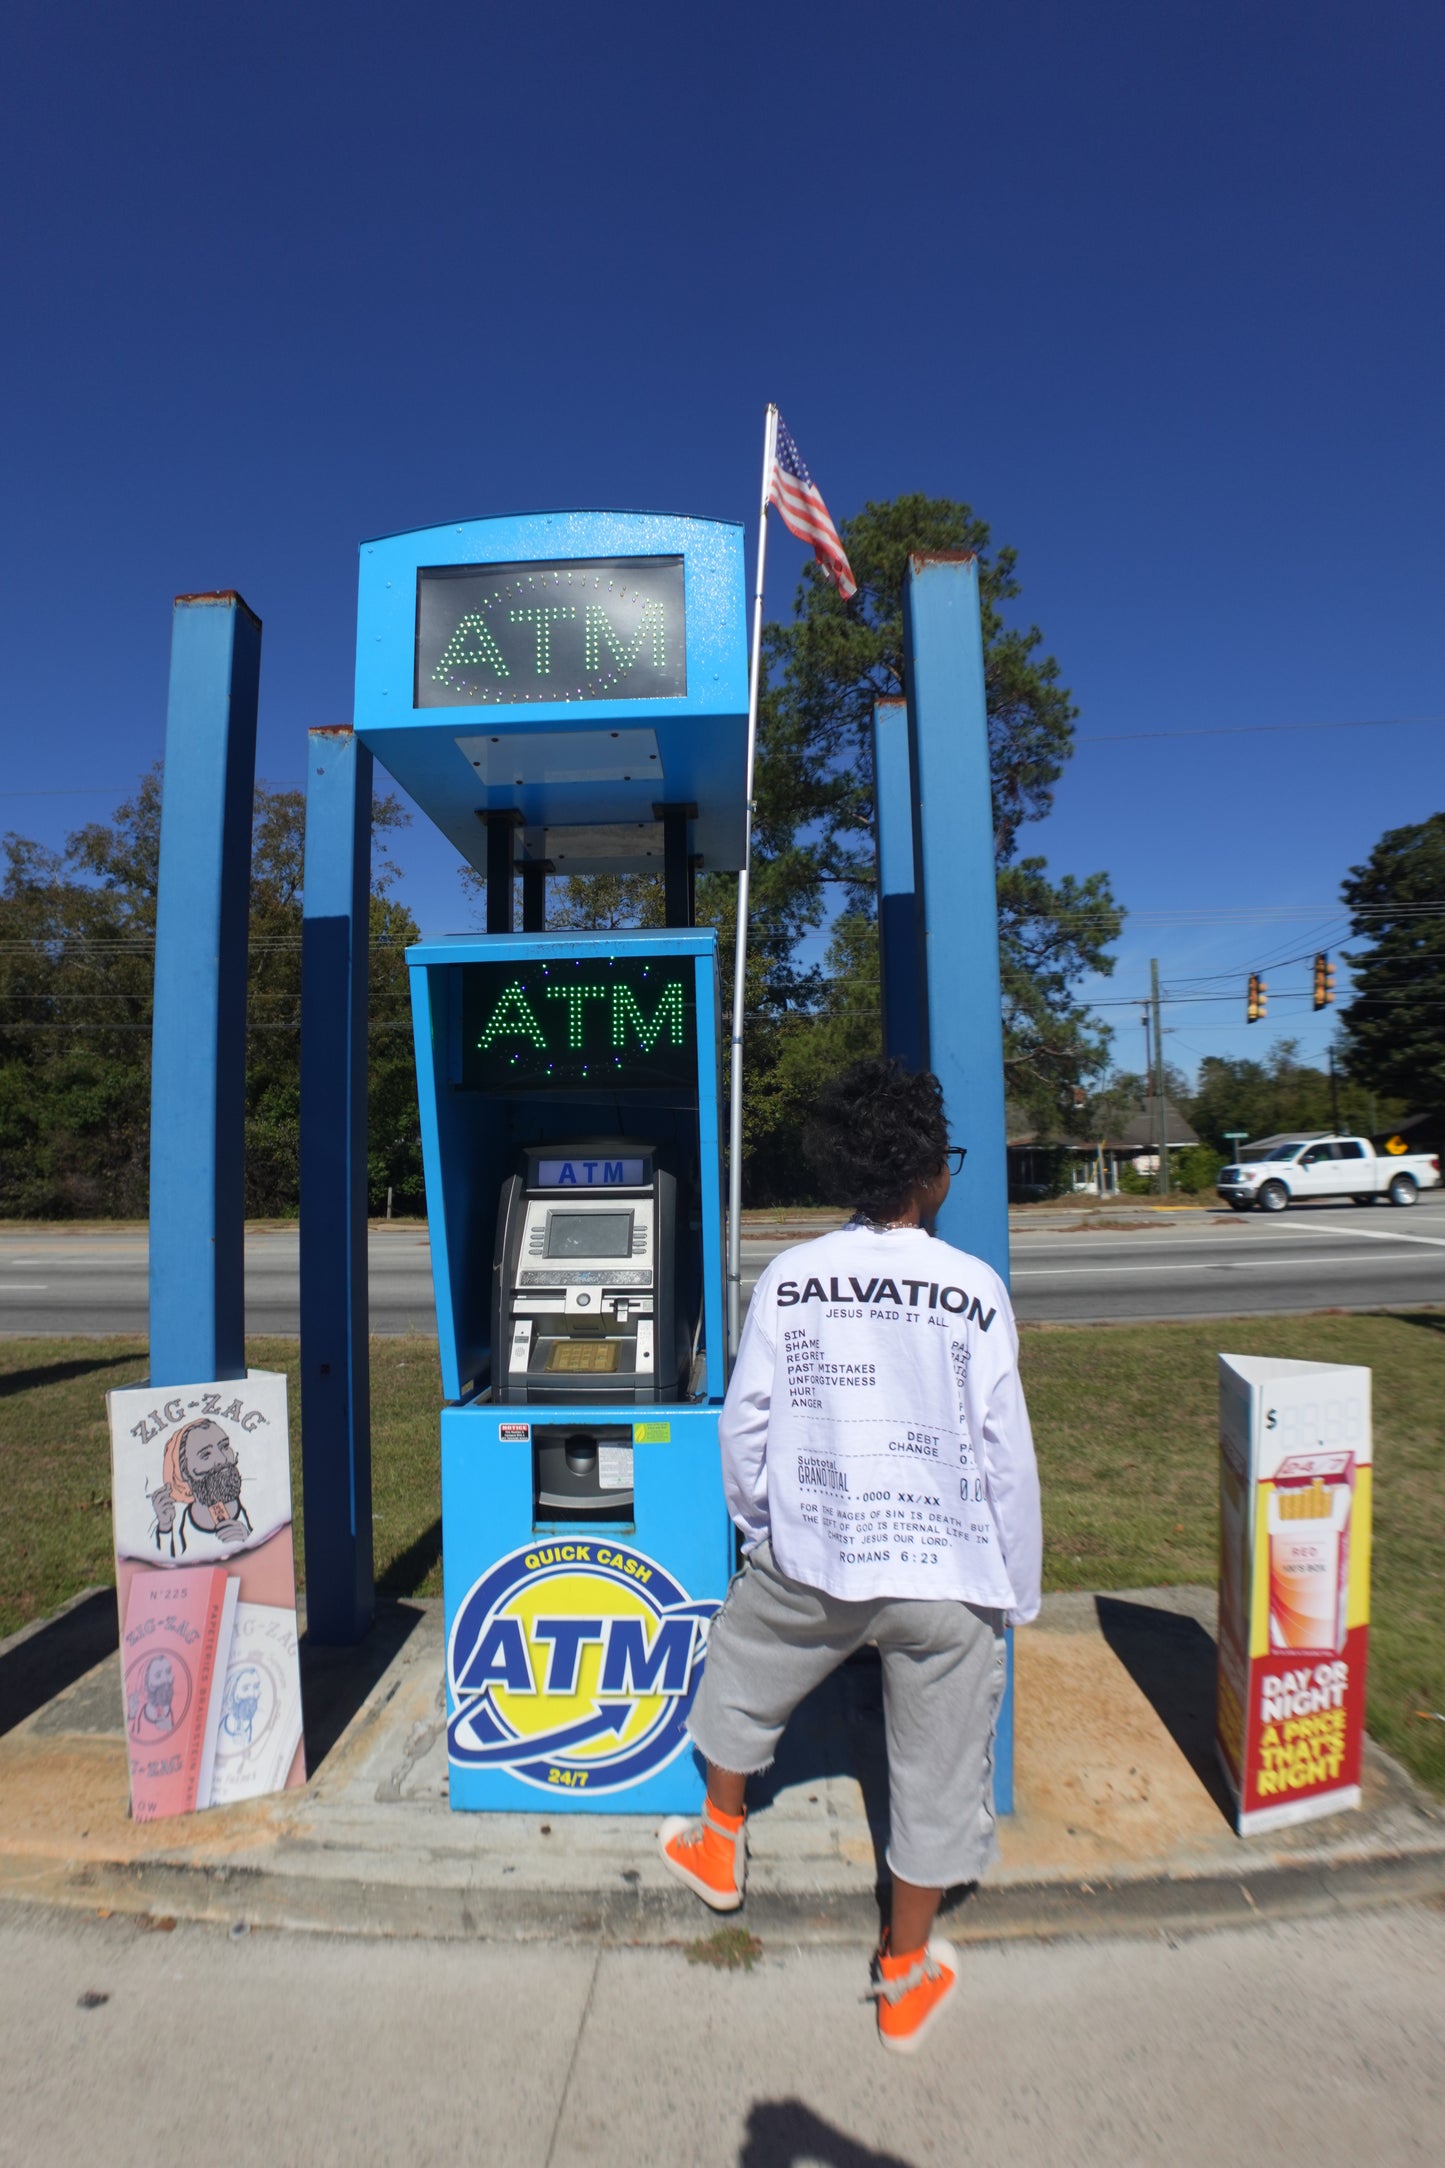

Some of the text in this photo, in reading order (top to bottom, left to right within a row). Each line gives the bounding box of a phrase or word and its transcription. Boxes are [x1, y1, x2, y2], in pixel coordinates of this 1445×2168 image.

[431, 602, 666, 681] ATM
[477, 981, 683, 1048] ATM
[558, 1161, 624, 1184] ATM
[777, 1277, 997, 1333] SALVATION
[826, 1309, 949, 1327] JESUS PAID IT ALL
[784, 1329, 806, 1341] SIN
[785, 1339, 819, 1352] SHAME
[787, 1351, 825, 1363] REGRET
[787, 1363, 876, 1374] PAST MISTAKES
[789, 1375, 876, 1386] UNFORGIVENESS
[790, 1387, 815, 1397] HURT
[791, 1398, 822, 1409] ANGER
[130, 1393, 267, 1444] ZIG-ZAG
[889, 1441, 939, 1457] CHANGE
[908, 1431, 939, 1446] DEBT
[798, 1456, 837, 1470] Subtotal
[798, 1466, 849, 1492] GRAND TOTAL
[898, 1492, 940, 1506] XX/XX
[800, 1503, 990, 1533] FOR THE WAGES OF SIN IS DEATH BUT
[803, 1514, 818, 1524] THE
[839, 1523, 850, 1532] OF
[856, 1523, 873, 1532] GOD
[877, 1522, 887, 1530] IS
[893, 1521, 939, 1534] ETERNAL
[946, 1528, 969, 1541] LIFE
[976, 1535, 989, 1544] IN
[827, 1530, 953, 1547] CHRIST JESUS OUR LORD.
[525, 1546, 652, 1584] QUICK CASH
[839, 1551, 938, 1565] ROMANS 6:23
[125, 1616, 200, 1647] ZIG-ZAG
[457, 1617, 697, 1692] ATM
[1261, 1660, 1349, 1699] DAY OR
[1261, 1681, 1349, 1723] NIGHT
[1261, 1708, 1347, 1747] A PRICE
[1259, 1731, 1346, 1770] THAT'S
[548, 1769, 589, 1787] 24/7
[1257, 1754, 1345, 1796] RIGHT
